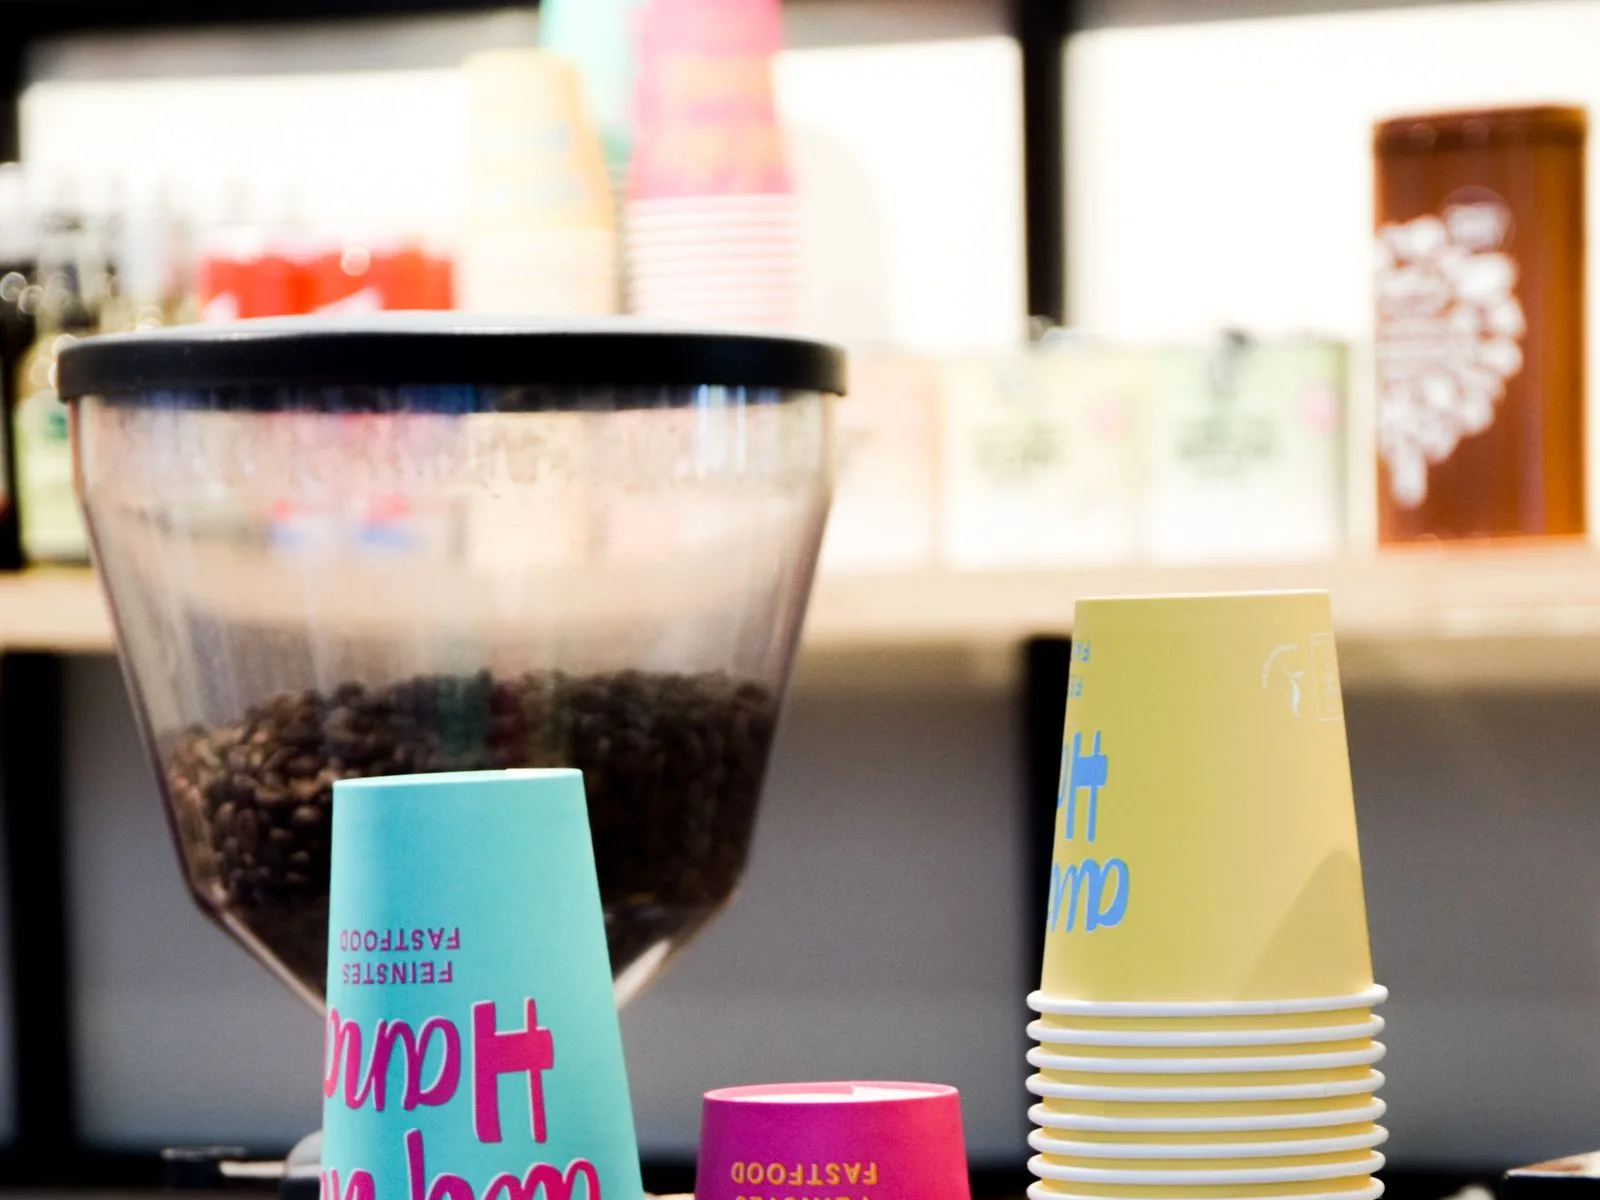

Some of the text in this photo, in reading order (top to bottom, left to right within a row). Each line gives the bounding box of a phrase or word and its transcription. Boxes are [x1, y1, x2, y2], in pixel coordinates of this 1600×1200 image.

[1057, 731, 1108, 843] H
[341, 928, 460, 951] FASTFOOD
[341, 961, 453, 984] FEINSTES
[731, 1162, 878, 1186] FASTFOOD
